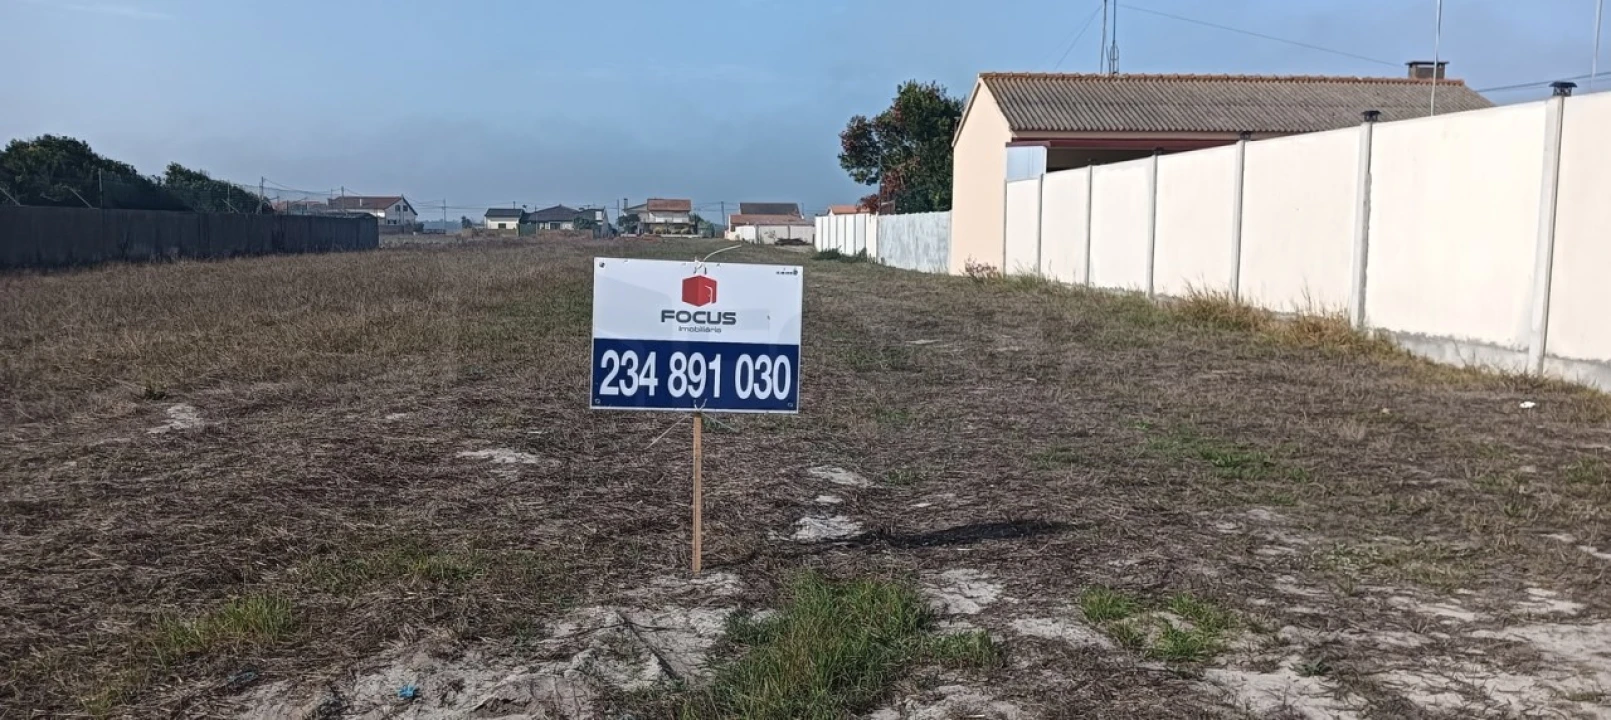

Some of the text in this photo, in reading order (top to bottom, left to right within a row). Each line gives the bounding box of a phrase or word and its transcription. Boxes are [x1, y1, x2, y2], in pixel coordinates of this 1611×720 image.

[661, 309, 737, 325] FOCUS
[599, 349, 791, 400] 234 891 030
